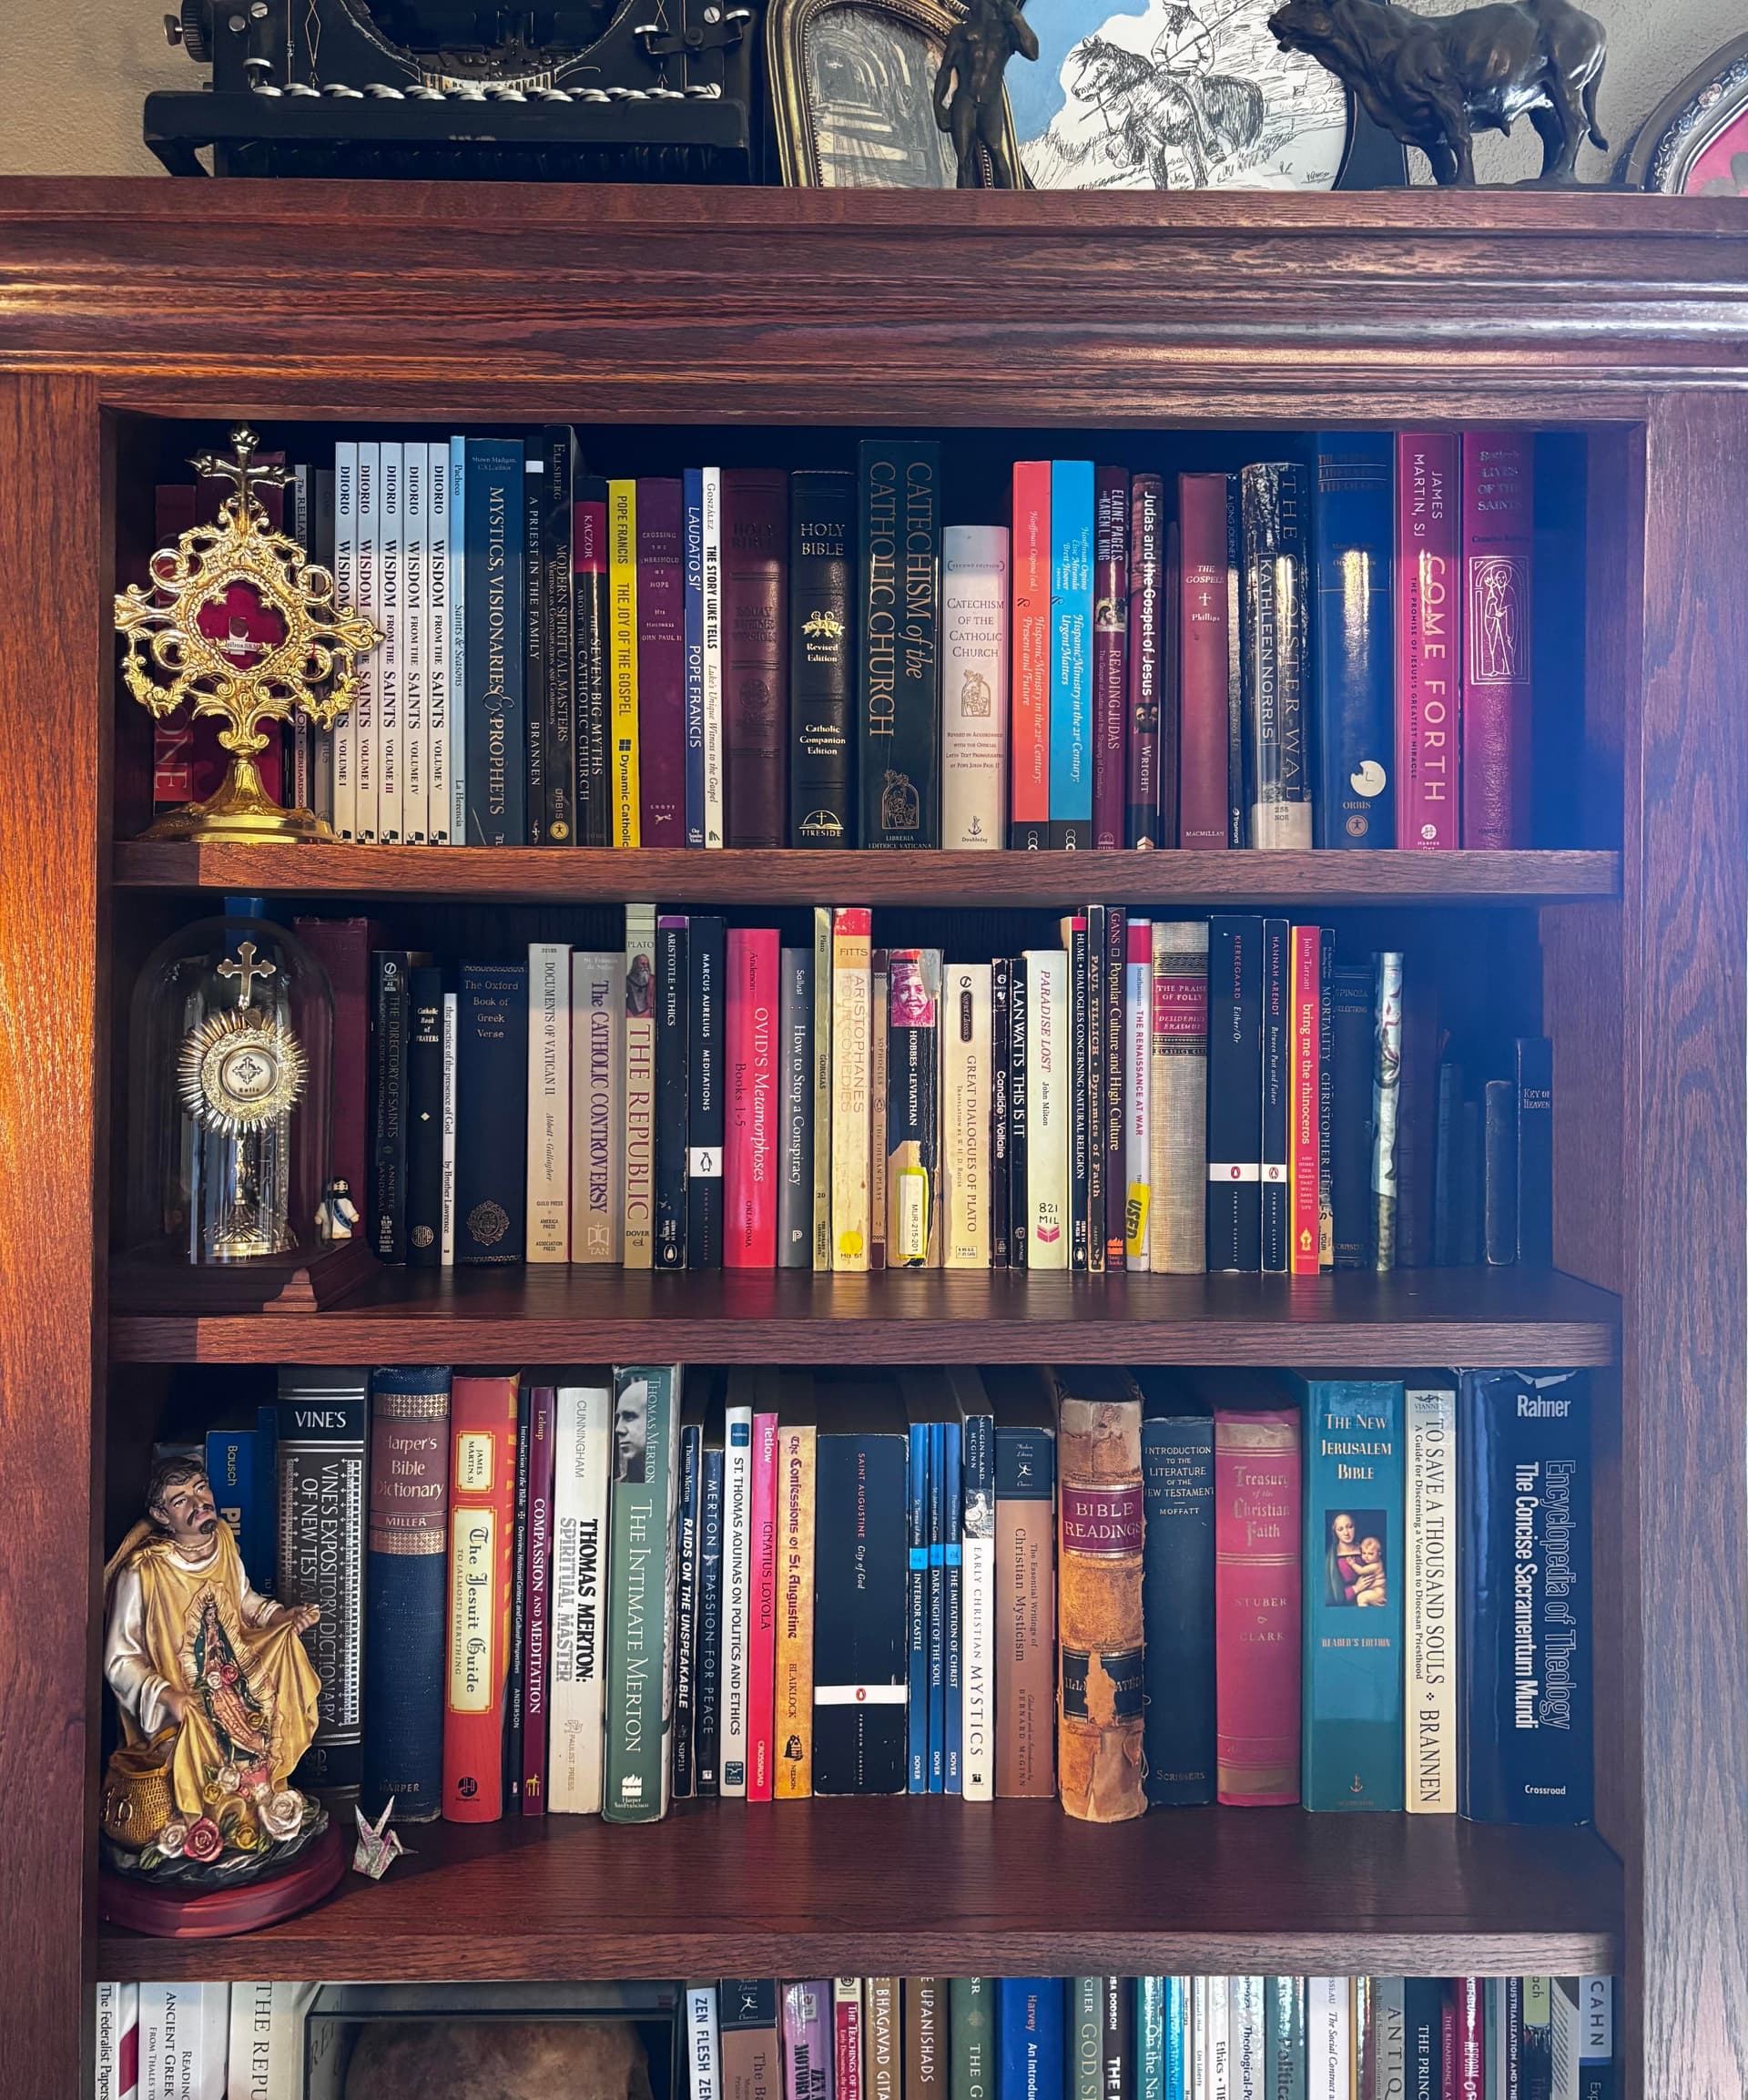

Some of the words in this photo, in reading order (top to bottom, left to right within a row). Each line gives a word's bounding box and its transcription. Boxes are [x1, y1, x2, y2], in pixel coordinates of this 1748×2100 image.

[340, 465, 351, 515] DIIORIO
[386, 465, 395, 514] DIIORIO
[434, 465, 442, 515] DIIORIO
[454, 464, 463, 495] Pacheco
[1413, 454, 1425, 515] MARTIN,
[1431, 471, 1442, 519] JAMES
[617, 495, 627, 522] POPE
[801, 524, 844, 537] HOLY
[584, 515, 593, 559] KACZOR
[618, 524, 628, 565] FRANCIS
[688, 506, 700, 568] LAUDATO
[802, 543, 844, 556] BIBLE
[869, 462, 896, 606] CATHOLIC
[905, 462, 933, 620] CATECHISM
[383, 540, 397, 608] WISDOM
[432, 540, 444, 608] WISDOM
[617, 583, 629, 603] THE
[618, 607, 630, 627] JOY
[707, 596, 716, 621] LUKE
[948, 598, 1004, 611] CATECHISM
[1192, 613, 1220, 621] Phillips
[1260, 559, 1272, 660] KATHLEEN
[1424, 554, 1446, 658] COME
[489, 576, 503, 696] VISIONARIES
[707, 624, 717, 648] TELLS
[807, 643, 838, 651] Revised
[950, 630, 1002, 641] CATHOLIC
[952, 647, 999, 658] CHURCH
[618, 647, 630, 669] THE
[689, 645, 701, 681] POPE
[869, 611, 895, 737] CHURCH
[384, 671, 396, 728] SAINTS
[432, 672, 443, 728] SAINTS
[618, 672, 631, 716] GOSPEL
[1262, 666, 1273, 739] NORRIS
[689, 687, 701, 748] FRANCIS
[805, 725, 839, 733] Catholic
[1108, 711, 1120, 749] JUDAS
[385, 739, 393, 780] VOLUME
[434, 739, 442, 779] VOLUME
[531, 722, 540, 786] BRANNEN
[800, 737, 846, 746] Companion
[1425, 681, 1446, 800] FORTH
[490, 718, 504, 815] PROPHETS
[620, 755, 630, 800] Dynamic
[1141, 746, 1151, 794] WRIGHT
[622, 804, 631, 847] Catholic
[627, 941, 654, 949] PLATO
[667, 933, 676, 984] ARISTOTLE
[484, 981, 518, 990] Oxford
[545, 963, 555, 1022] DOCUMENTS
[591, 980, 610, 1008] The
[702, 953, 710, 991] MARCUS
[478, 1014, 505, 1023] Greek
[667, 994, 676, 1026] ETHICS
[702, 994, 710, 1037] AURELIUS
[1013, 980, 1023, 1019] ALAN
[1040, 970, 1051, 1036] PARADISE
[1299, 1004, 1313, 1035] bring
[478, 1030, 504, 1038] Verse
[591, 1011, 610, 1088] CATHOLIC
[755, 1007, 769, 1066] OVID'S
[794, 1025, 805, 1055] How
[1013, 1022, 1024, 1066] WATTS
[1110, 1007, 1122, 1051] Culture
[545, 1042, 555, 1085] VATICAN
[630, 1024, 651, 1080] THE
[1041, 1042, 1052, 1073] LOST
[702, 1049, 710, 1111] MEDITATIONS
[736, 1063, 746, 1102] Books
[790, 1075, 805, 1103] Stop
[997, 1071, 1006, 1114] Candide
[1014, 1077, 1024, 1105] THIS
[1108, 1077, 1122, 1104] High
[749, 1070, 770, 1181] Metamorphoses
[967, 1099, 977, 1169] DIALOGUES
[1110, 1108, 1122, 1151] Culture
[1302, 1082, 1311, 1145] rhinoceros
[590, 1095, 609, 1213] CONTROVERSY
[627, 1091, 651, 1220] REPUBLIC
[789, 1116, 804, 1185] Conspiracy
[997, 1118, 1006, 1158] Voltaire
[744, 1200, 752, 1248] OKLAHOMA
[967, 1195, 977, 1233] PLATO
[1039, 1203, 1058, 1213] 821
[1039, 1216, 1059, 1224] MIL
[1125, 1198, 1143, 1239] USED
[295, 1411, 346, 1428] VINE'S
[537, 1410, 546, 1441] Leloup
[1326, 1414, 1352, 1430] THE
[1357, 1416, 1387, 1430] NEW
[1518, 1394, 1570, 1418] Rahner
[575, 1400, 585, 1478] CUNNINGHAM
[763, 1425, 776, 1464] Tetlow
[1321, 1440, 1392, 1456] JERUSALEM
[1426, 1418, 1444, 1442] TO
[228, 1444, 237, 1486] Bausch
[391, 1462, 425, 1476] Bible
[1150, 1467, 1206, 1476] LITERATURE
[1337, 1464, 1374, 1480] BIBLE
[1426, 1448, 1444, 1494] SAVE
[1515, 1462, 1539, 1492] The
[321, 1463, 338, 1514] VINE'S
[733, 1477, 743, 1527] THOMAS
[789, 1459, 801, 1534] Confessions
[1076, 1503, 1134, 1516] BIBLE
[385, 1517, 426, 1527] MILLER
[630, 1500, 653, 1540] THE
[706, 1480, 717, 1546] MERTON
[1064, 1522, 1143, 1539] READINGS
[1160, 1507, 1199, 1515] MOFFATT
[1515, 1496, 1539, 1559] Concise
[1540, 1460, 1576, 1596] Encyclopedia
[533, 1498, 545, 1592] COMPASSION
[578, 1519, 598, 1596] THOMAS
[683, 1518, 693, 1557] RAIDS
[1015, 1528, 1026, 1591] Christian
[320, 1516, 337, 1618] EXPOSITORY
[1426, 1517, 1444, 1619] THOUSAND
[626, 1548, 652, 1652] INTIMATE
[682, 1585, 691, 1610] THE
[787, 1576, 800, 1639] Augustine
[575, 1601, 595, 1683] MERTON:
[731, 1608, 741, 1660] POLITICS
[1015, 1595, 1025, 1661] Mysticism
[1515, 1564, 1538, 1677] Sacramentum
[319, 1622, 336, 1723] DICTIONARY
[530, 1620, 543, 1714] MEDITATION
[679, 1614, 690, 1708] UNSPEAKABLE
[1426, 1625, 1445, 1684] SOULS
[1540, 1630, 1577, 1730] Theology
[625, 1657, 648, 1753] MERTON
[730, 1693, 741, 1736] ETHICS
[971, 1666, 983, 1756] MYSTICS
[1515, 1680, 1539, 1728] Mundi
[757, 1741, 766, 1787] CROSSROAD
[1419, 1709, 1440, 1802] BRANNEN
[1525, 1785, 1566, 1795] Crossroad
[101, 1985, 111, 2007] The
[696, 1998, 708, 2023] ZEN
[1025, 1994, 1037, 2032] Harvey
[1590, 1981, 1604, 2046] CAHN
[100, 2011, 112, 2063] Federalist
[165, 1992, 177, 2051] ANCIENT
[876, 1990, 890, 2064] BHAGAVAD
[920, 1990, 934, 2082] UPANISHADS
[696, 2030, 709, 2072] FLESH
[849, 2024, 858, 2073] TEACHINGS
[165, 2055, 176, 2097] GREEK
